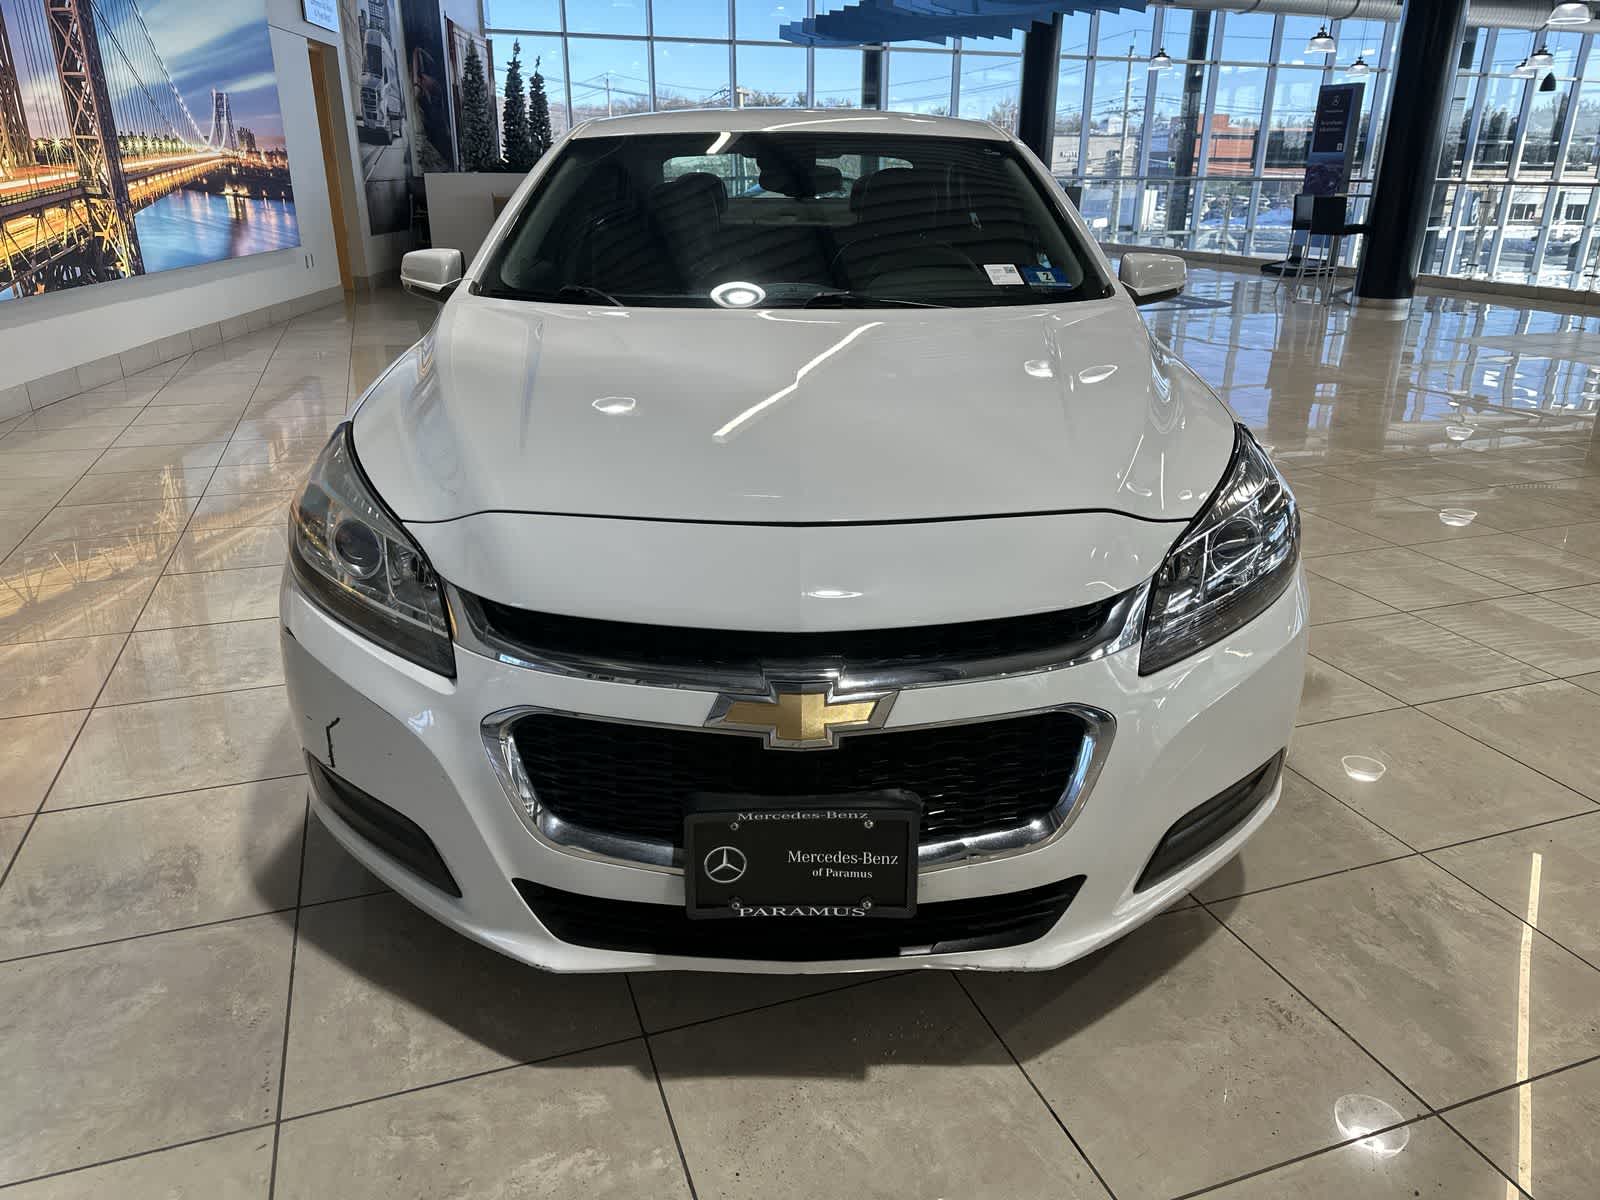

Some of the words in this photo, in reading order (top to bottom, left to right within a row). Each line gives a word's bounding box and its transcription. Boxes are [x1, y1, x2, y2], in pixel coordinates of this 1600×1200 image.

[737, 811, 869, 821] Mercedes-Benz
[787, 850, 899, 865] Mercedes-Benz
[812, 867, 823, 877] of
[826, 867, 873, 879] Paramus
[739, 906, 866, 917] PARAMUS
